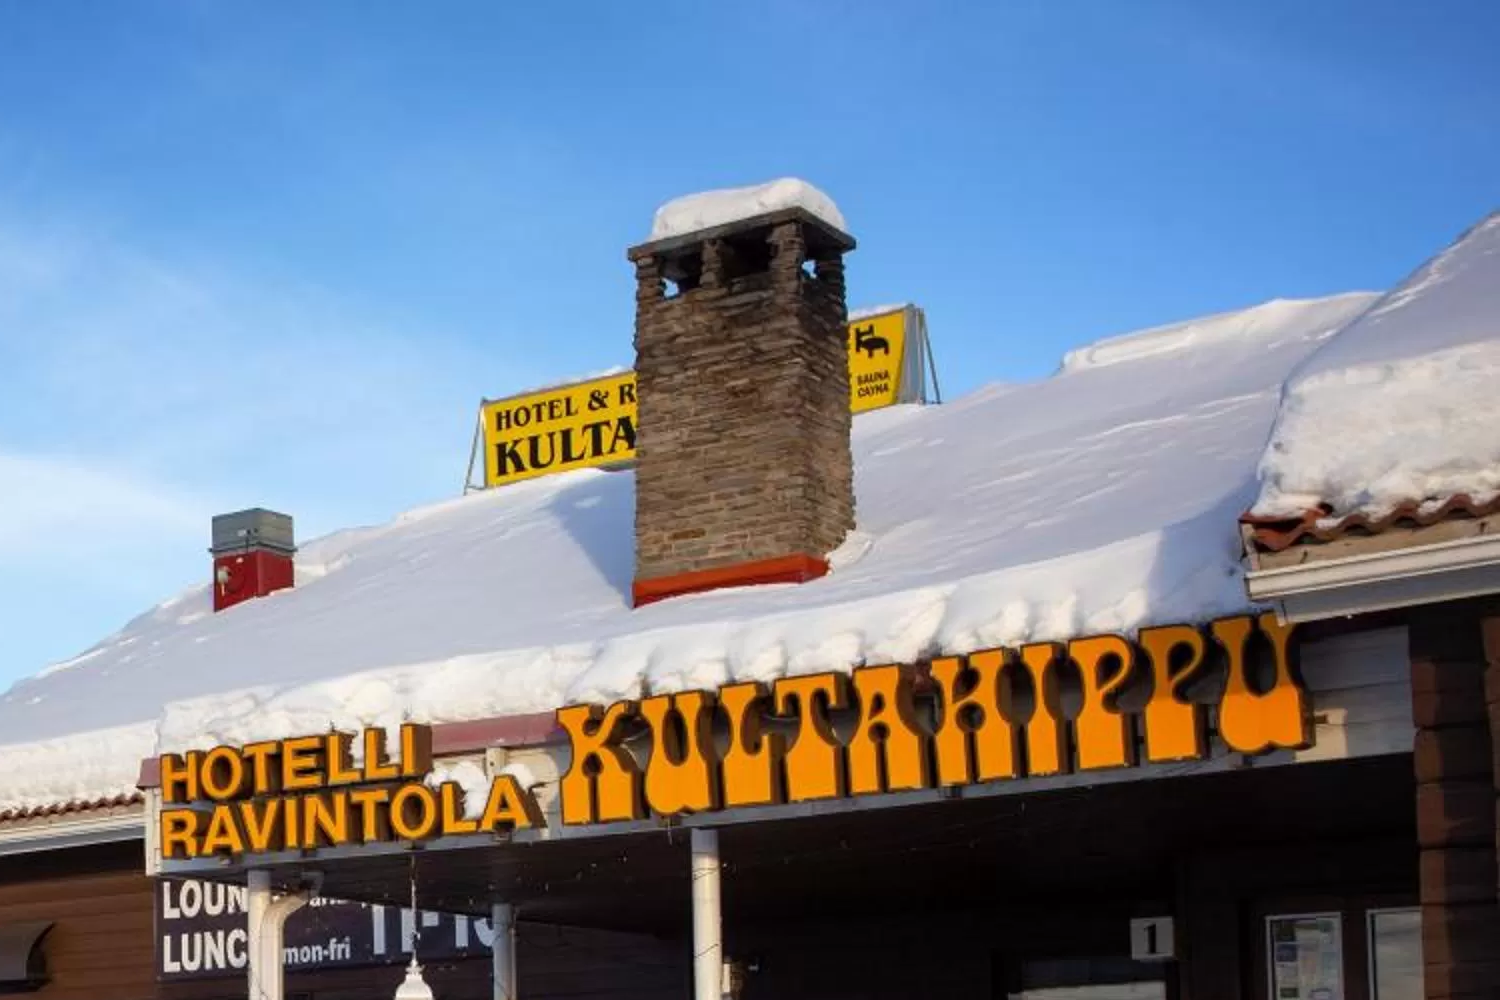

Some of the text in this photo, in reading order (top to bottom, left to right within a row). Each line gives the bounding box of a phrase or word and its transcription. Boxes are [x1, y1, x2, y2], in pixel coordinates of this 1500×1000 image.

[495, 383, 636, 432] HOTEL & R
[494, 415, 636, 477] KULTA
[556, 612, 1306, 825] KULTAHIPPU
[160, 723, 422, 804] HOTELLI
[160, 774, 538, 860] RAVINTOLA
[163, 879, 248, 919] LOUN
[163, 928, 350, 972] LUNC mon-fri
[1144, 922, 1157, 955] 1
